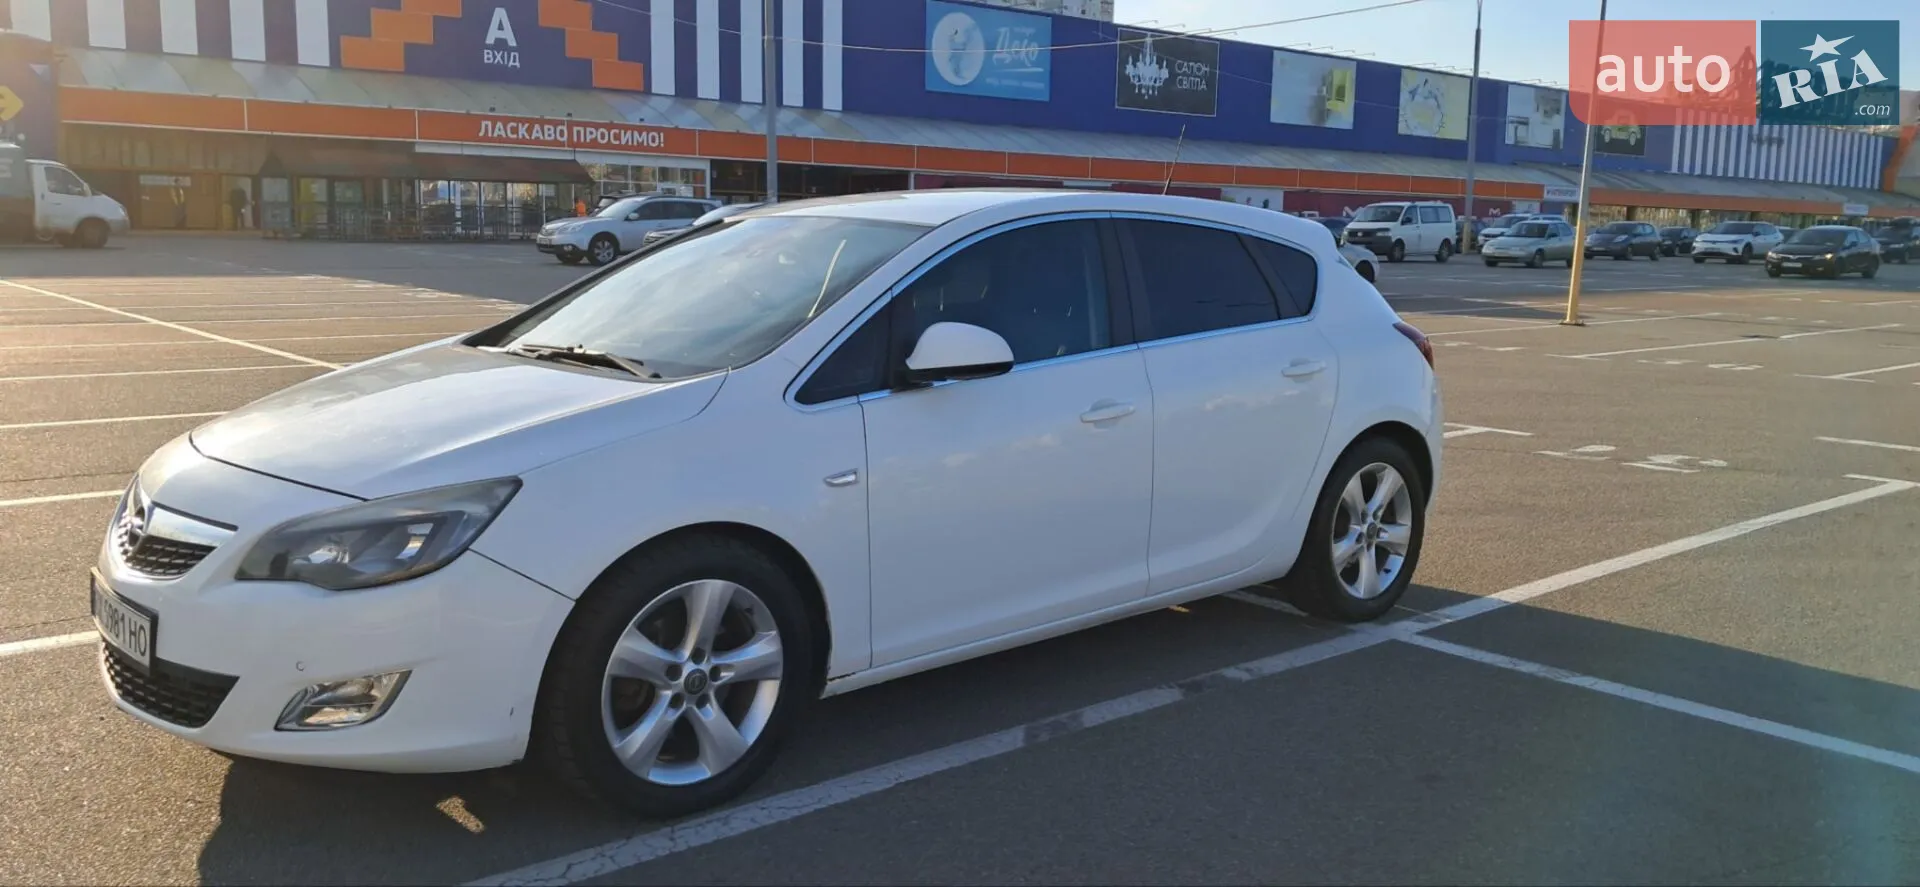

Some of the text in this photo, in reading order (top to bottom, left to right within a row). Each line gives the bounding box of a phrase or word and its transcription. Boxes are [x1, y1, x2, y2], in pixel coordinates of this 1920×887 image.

[483, 49, 520, 68] ВХІД
[1175, 60, 1209, 77] САЛОН
[1176, 76, 1207, 91] СВІТЛА
[478, 120, 664, 147] ЛАСКАВО ПРОСИМО!
